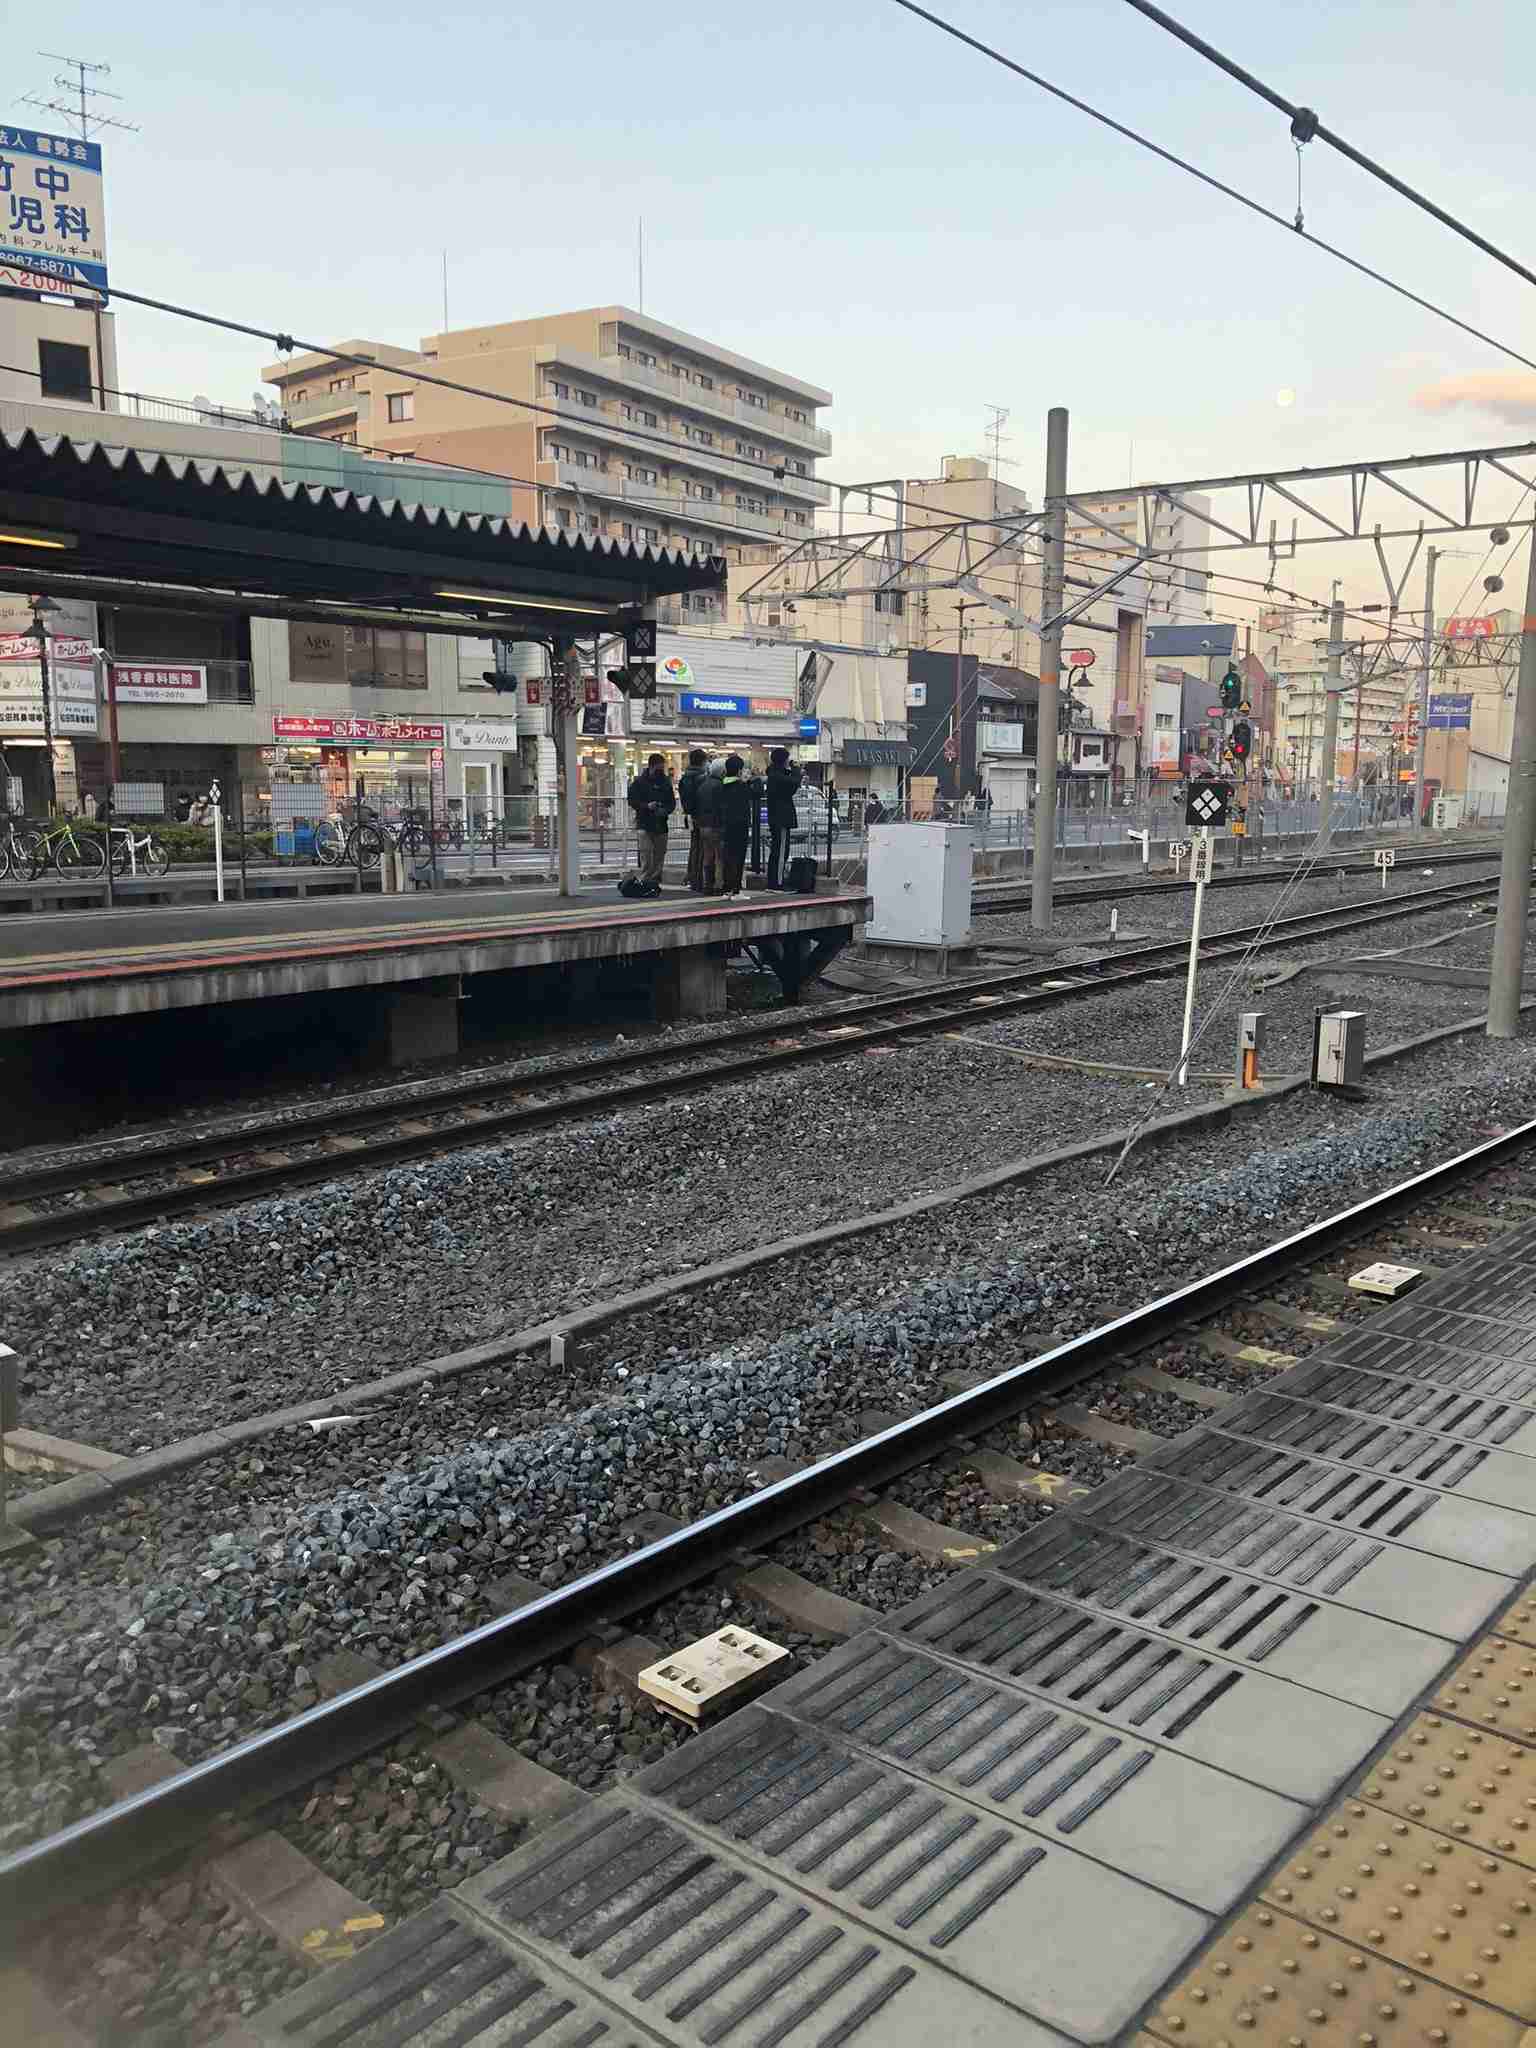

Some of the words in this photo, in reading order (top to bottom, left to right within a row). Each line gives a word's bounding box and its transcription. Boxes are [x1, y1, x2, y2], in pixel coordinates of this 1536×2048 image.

[693, 697, 738, 711] Panasonic
[1171, 844, 1184, 858] 45
[1377, 851, 1393, 865] 45
